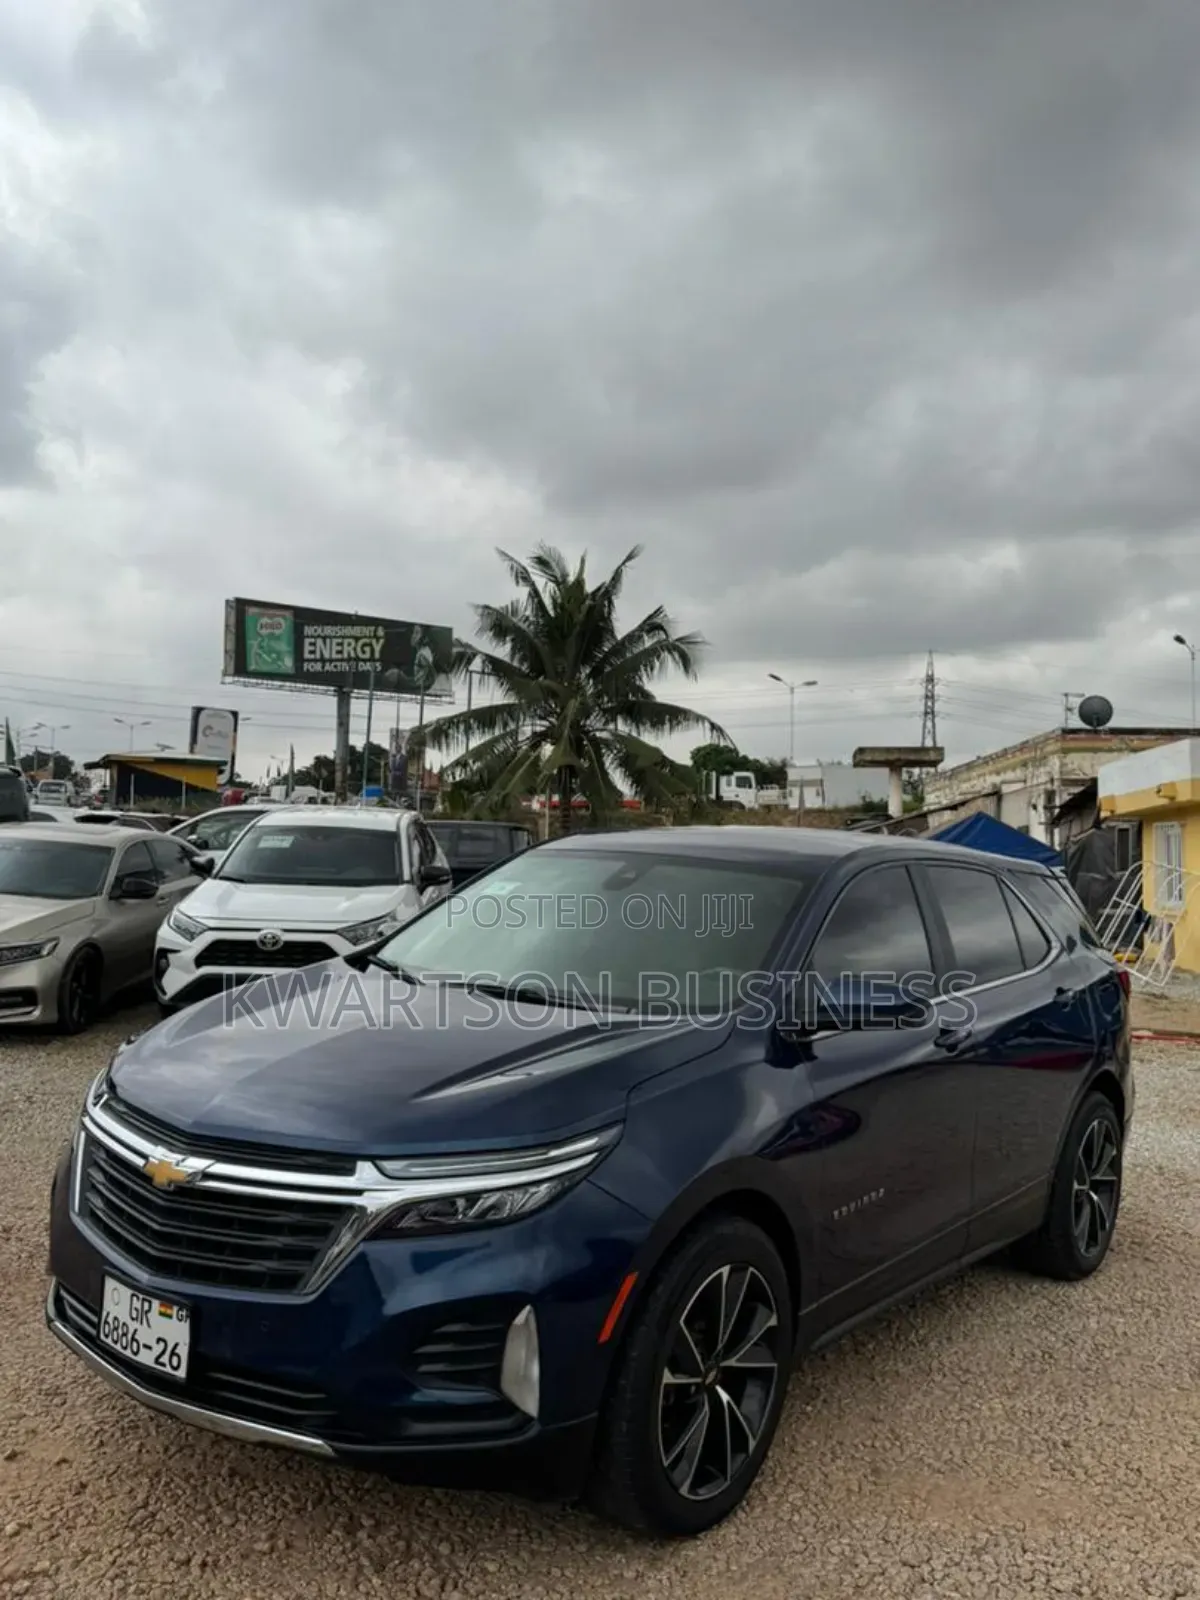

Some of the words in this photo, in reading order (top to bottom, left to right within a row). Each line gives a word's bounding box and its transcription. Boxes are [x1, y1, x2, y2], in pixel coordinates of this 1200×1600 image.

[303, 638, 385, 660] ENERGY
[303, 661, 322, 672] FOR
[129, 1293, 153, 1329] GR
[102, 1311, 182, 1371] 6886-26
